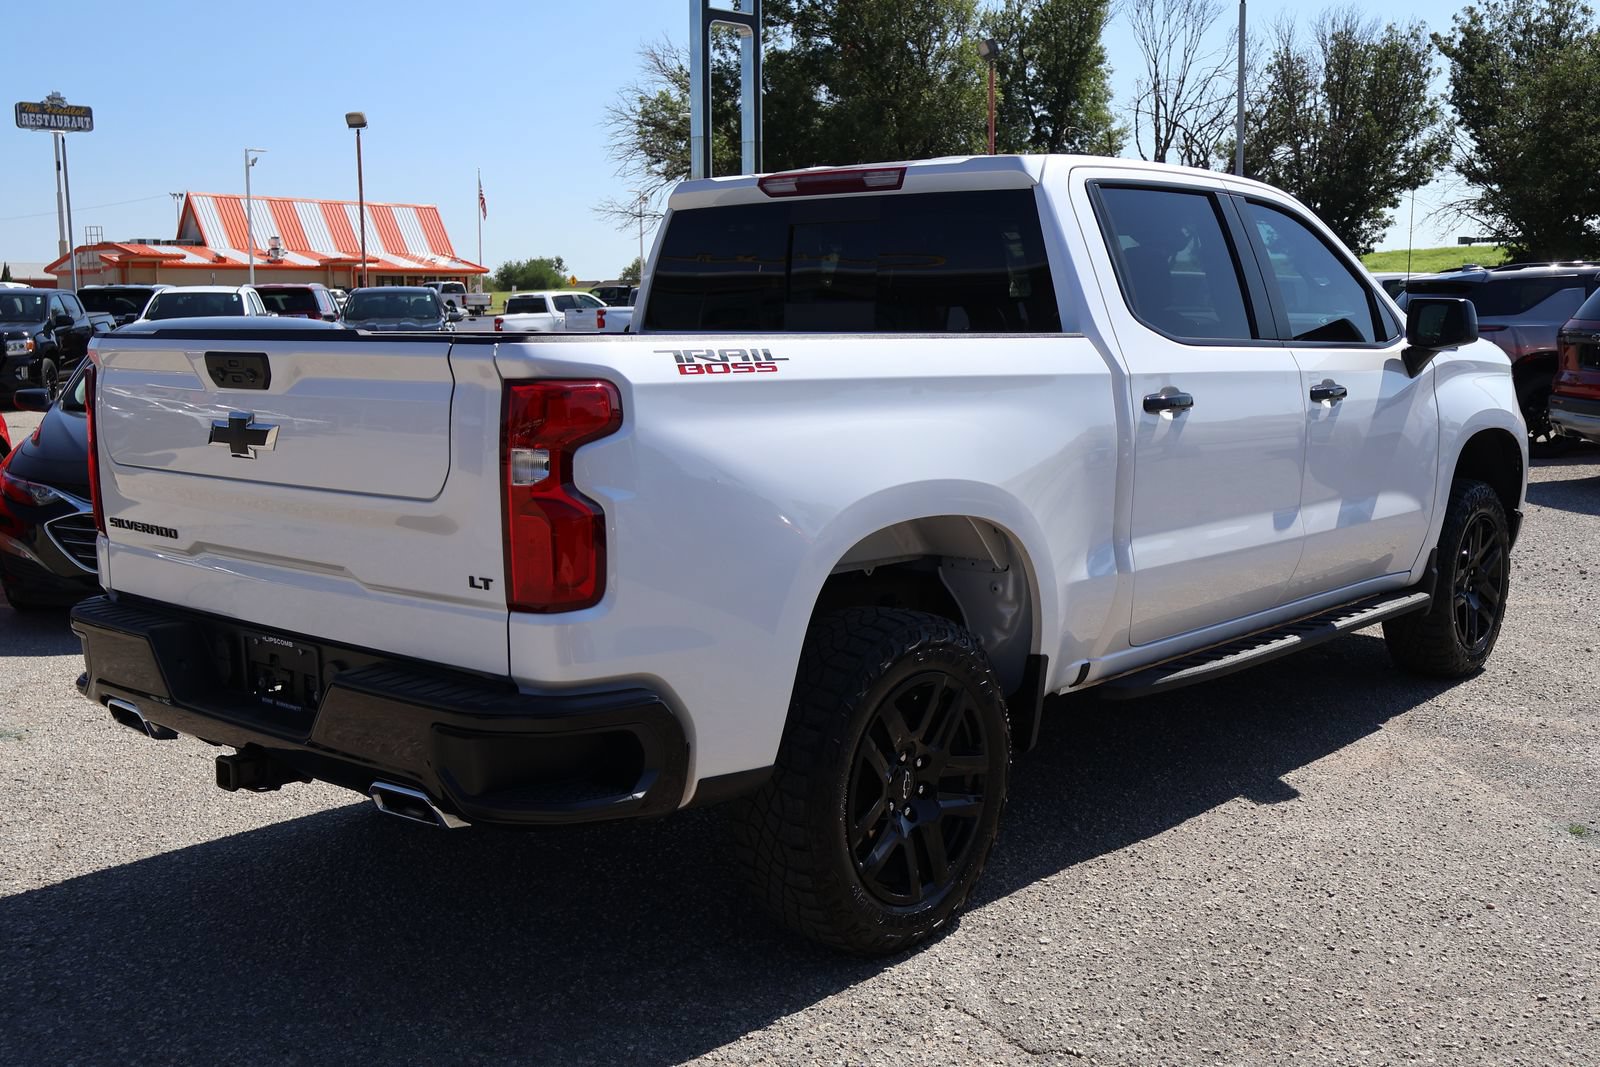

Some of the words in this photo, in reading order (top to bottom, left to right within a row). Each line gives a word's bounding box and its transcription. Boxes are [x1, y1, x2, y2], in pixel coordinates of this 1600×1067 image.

[21, 113, 91, 129] RESTAURANT
[653, 348, 790, 363] TRAIL
[677, 361, 778, 375] BOSS
[109, 516, 178, 539] SILVERADO
[468, 575, 494, 591] LT
